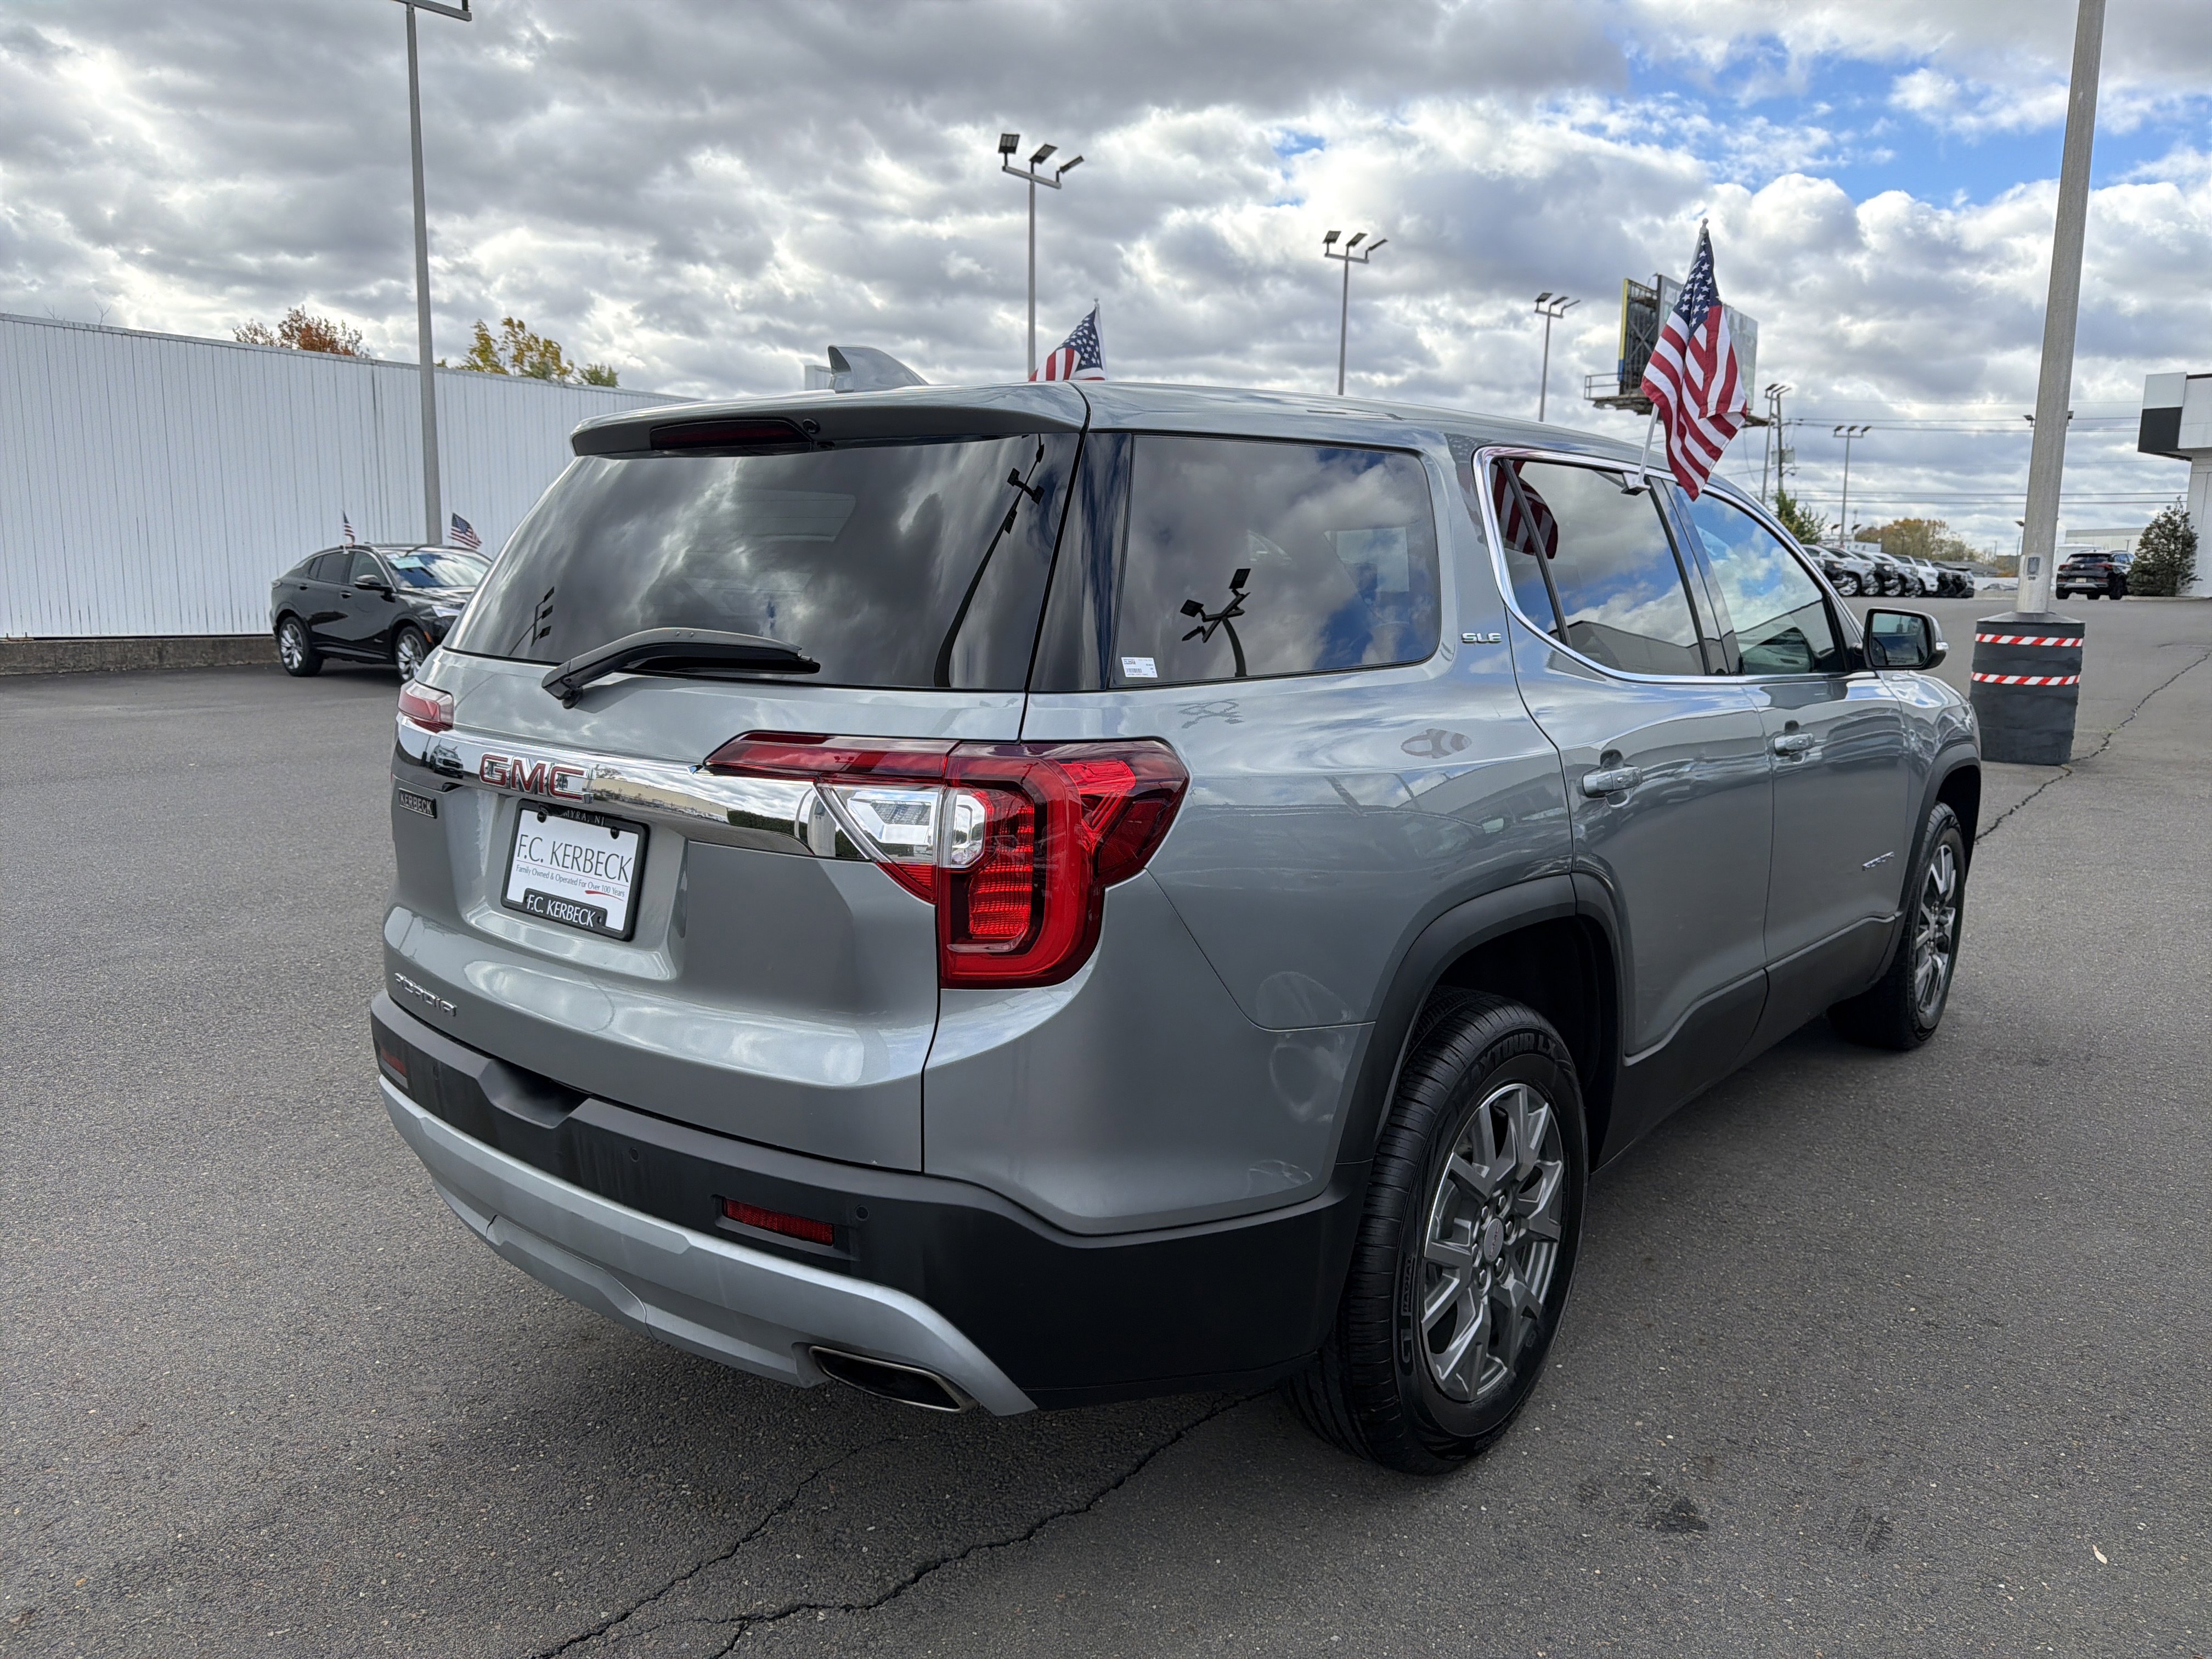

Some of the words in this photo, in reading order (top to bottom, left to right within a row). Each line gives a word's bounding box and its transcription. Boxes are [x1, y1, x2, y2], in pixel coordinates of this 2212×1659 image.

[1462, 632, 1502, 643] SLE
[479, 752, 594, 804] GMC
[399, 792, 432, 815] KERBECK
[563, 809, 590, 823] MYRA,
[517, 834, 544, 863] F.C.
[550, 840, 633, 883] KERBECK
[516, 864, 531, 876] Family
[532, 868, 550, 879] Owned
[555, 873, 578, 886] Operated
[588, 881, 601, 891] Over
[601, 884, 611, 894] 100
[612, 887, 625, 898] Years
[526, 894, 544, 913] F.C.
[546, 899, 596, 928] KERBECK
